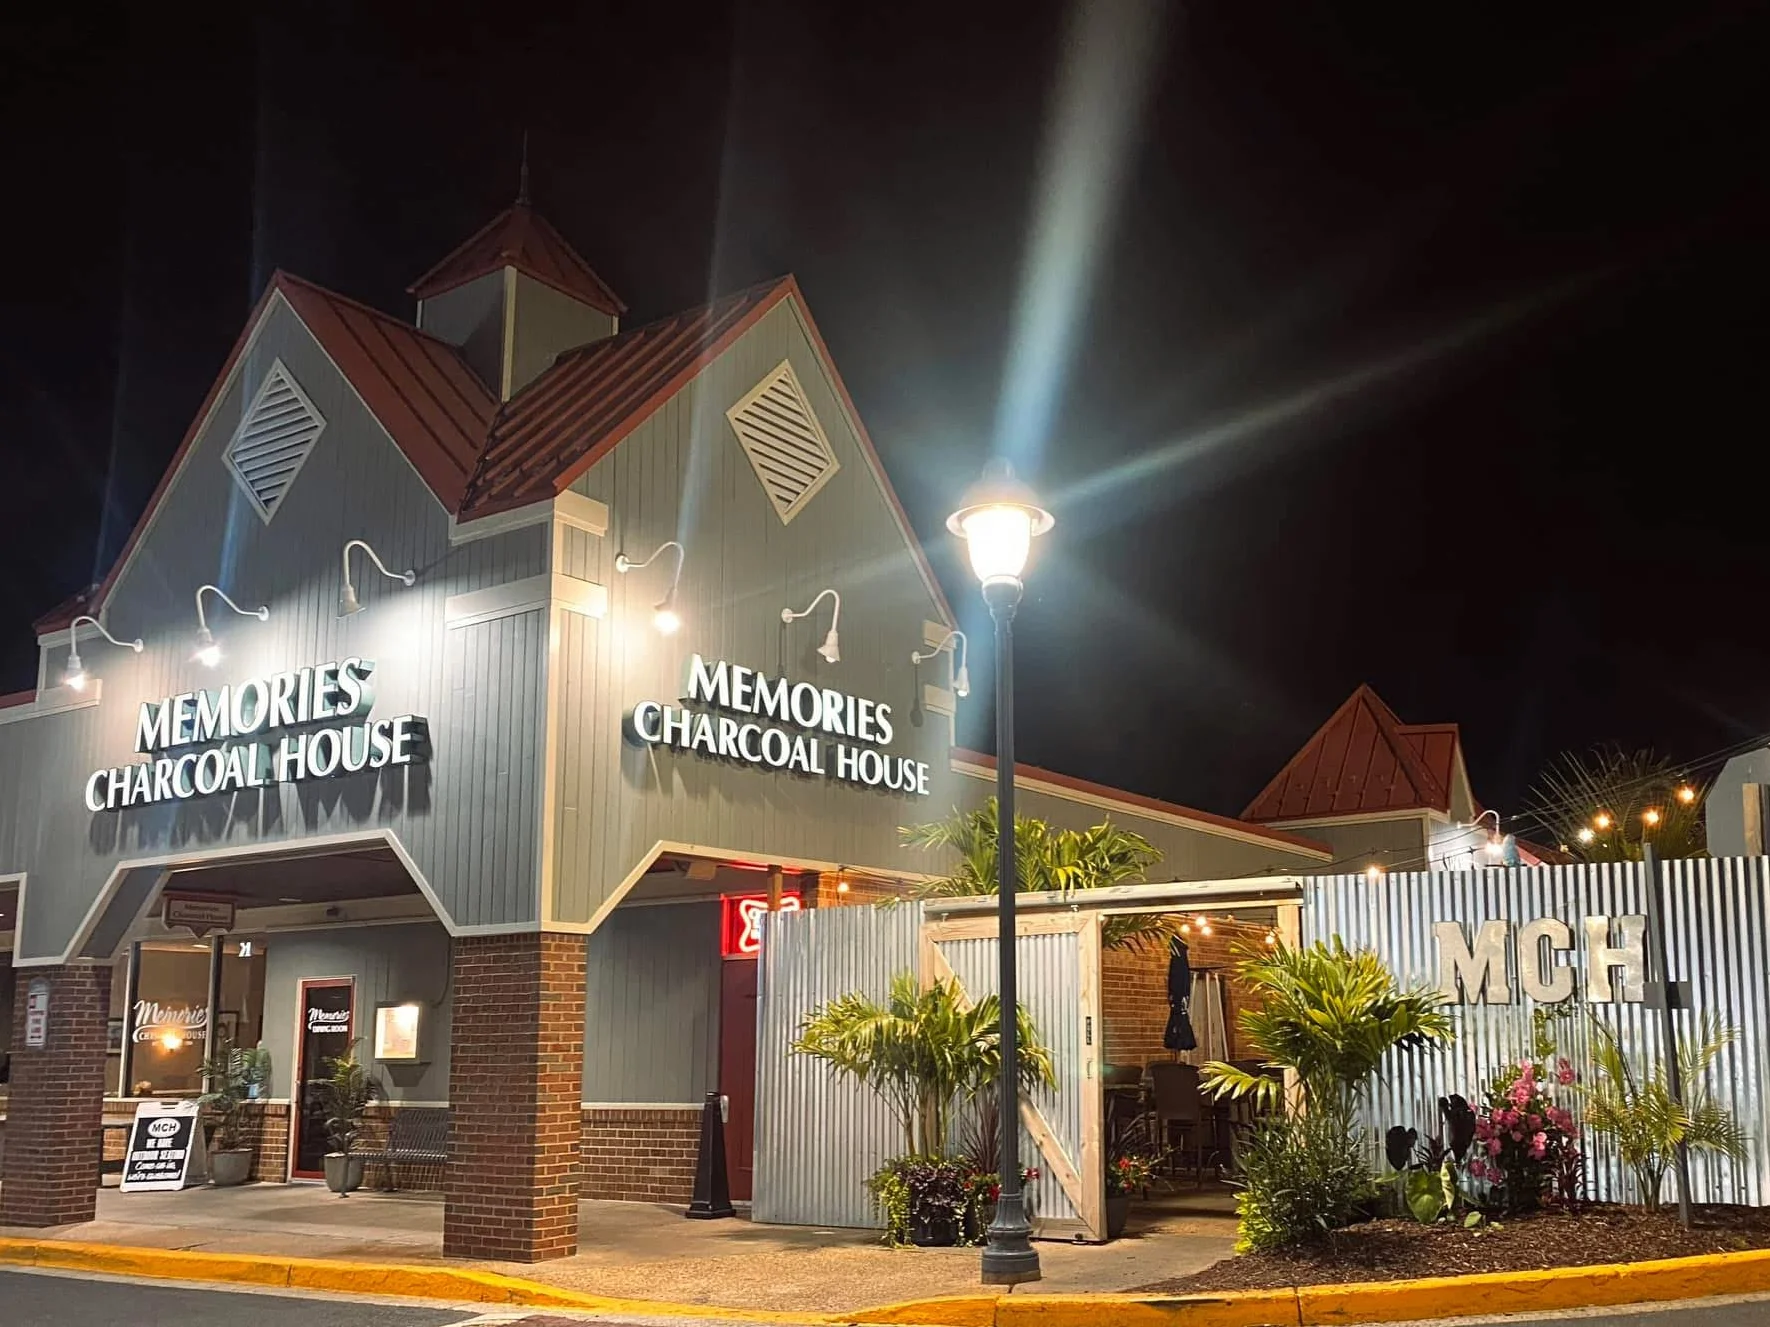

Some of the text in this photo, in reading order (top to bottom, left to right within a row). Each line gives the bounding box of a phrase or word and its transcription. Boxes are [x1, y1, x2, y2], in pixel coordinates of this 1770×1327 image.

[134, 656, 366, 754] MEMORIES
[688, 654, 893, 745] MEMORIES
[85, 715, 413, 812] CHARCOAL HOUSE
[634, 700, 930, 796] CHARCOAL HOUSE
[1431, 914, 1648, 1006] MCH
[151, 1123, 177, 1132] MCH
